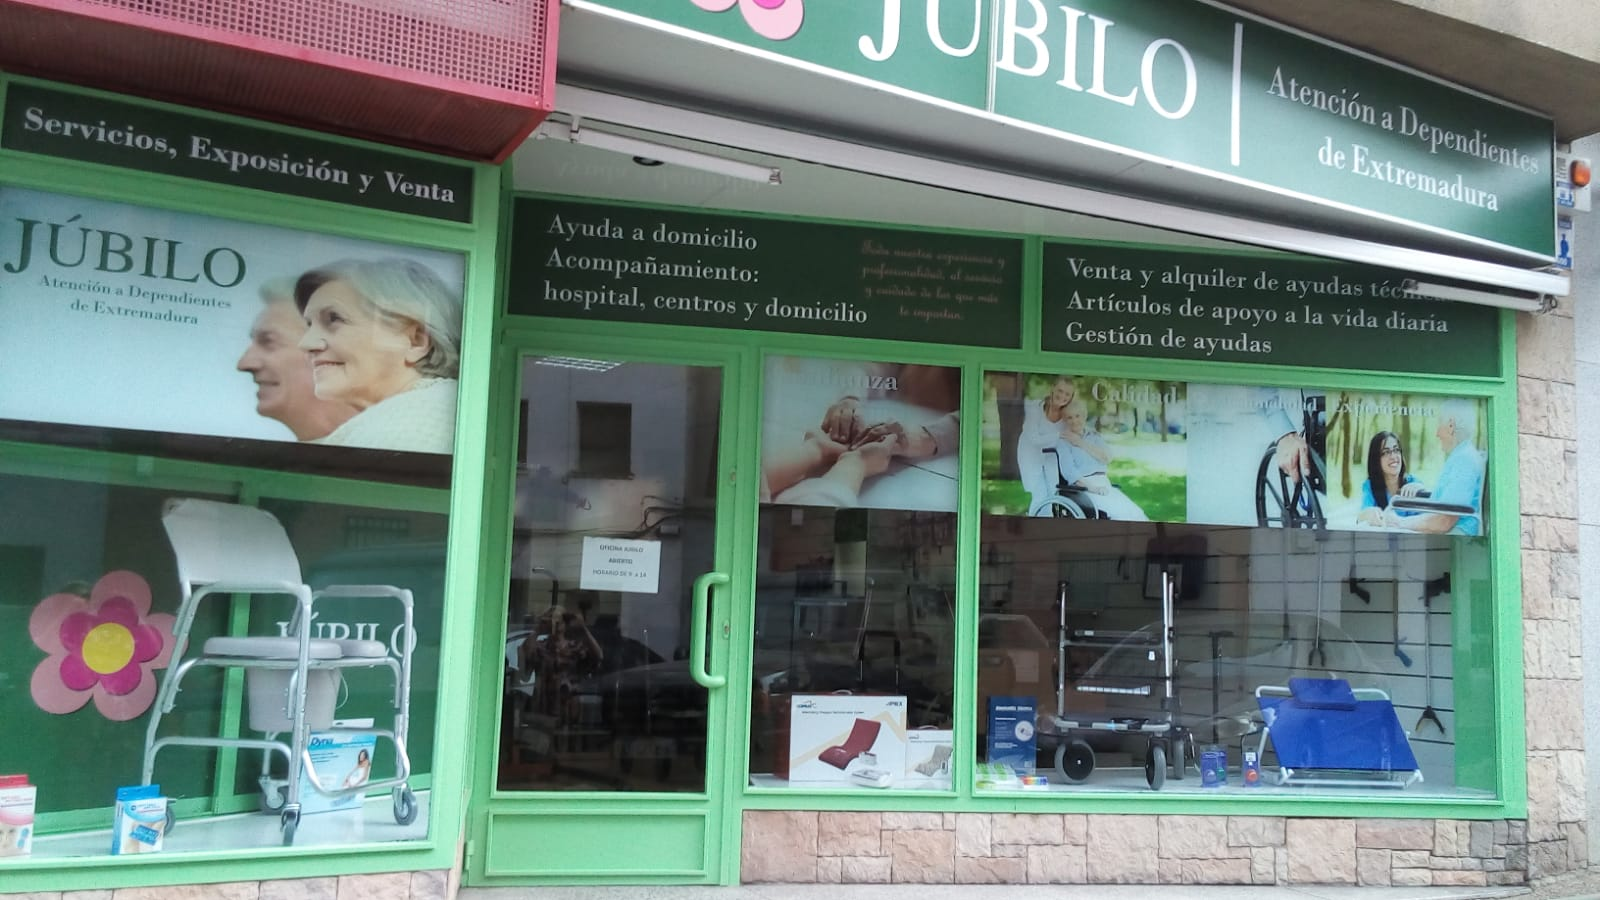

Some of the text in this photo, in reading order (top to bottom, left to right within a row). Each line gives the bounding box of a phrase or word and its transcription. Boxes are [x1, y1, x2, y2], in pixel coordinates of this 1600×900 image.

[1266, 65, 1539, 175] Atención a Dependientes
[23, 106, 456, 203] Servicios, Exposición y Venta
[1317, 136, 1346, 170] de
[1351, 143, 1499, 212] Extremadura
[3, 213, 248, 288] JÚBILO
[547, 213, 758, 250] Ayuda a domicilio
[545, 247, 759, 283] Acompañamiento:
[1066, 257, 1132, 281] Venta
[1140, 269, 1155, 288] y
[1161, 265, 1247, 291] alquiler
[1253, 271, 1279, 291] de
[1286, 276, 1363, 298] ayudas
[40, 273, 232, 310] Atención a Dependientes
[70, 299, 199, 326] de Extremadura
[543, 280, 868, 323] hospital, centros y domicilio
[1066, 290, 1449, 333] Artículos de apoyo a la vida diaria
[1065, 321, 1272, 356] Gestión de ayudas
